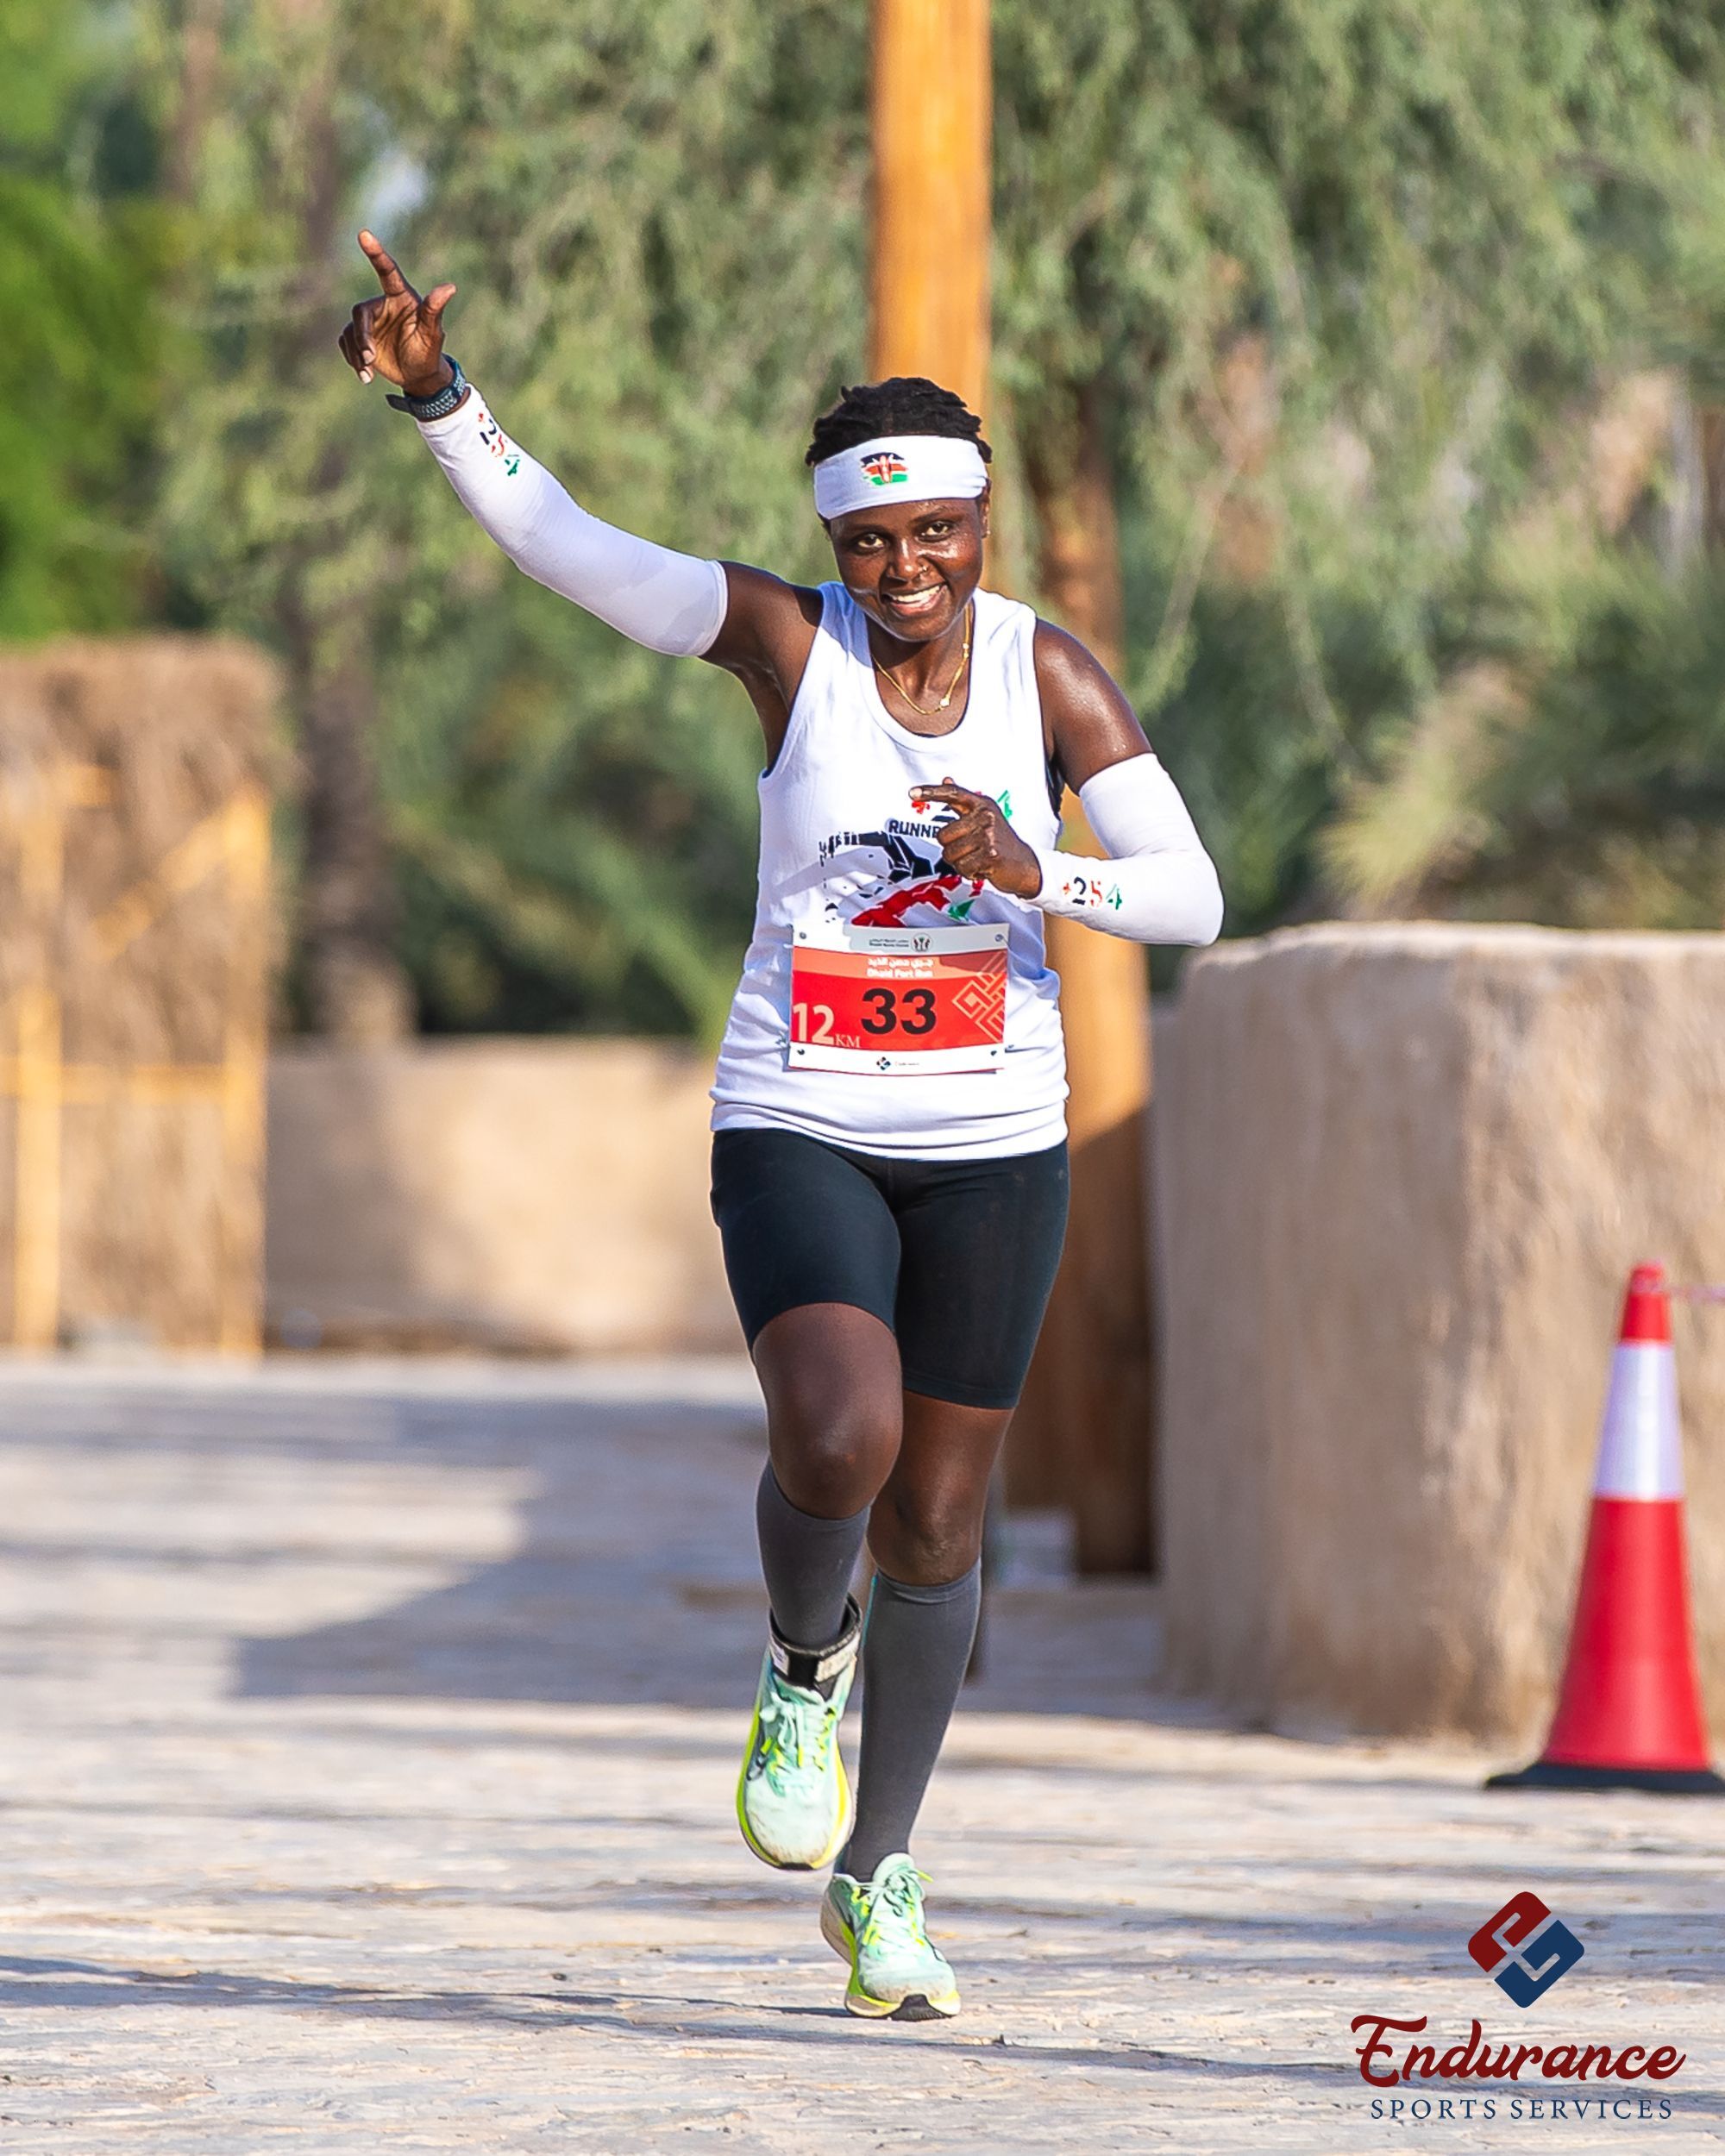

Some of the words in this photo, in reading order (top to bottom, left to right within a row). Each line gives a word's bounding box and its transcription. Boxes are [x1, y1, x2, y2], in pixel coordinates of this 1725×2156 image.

[793, 1002, 835, 1046] 12
[835, 1034, 861, 1049] KM
[861, 987, 937, 1035] 33
